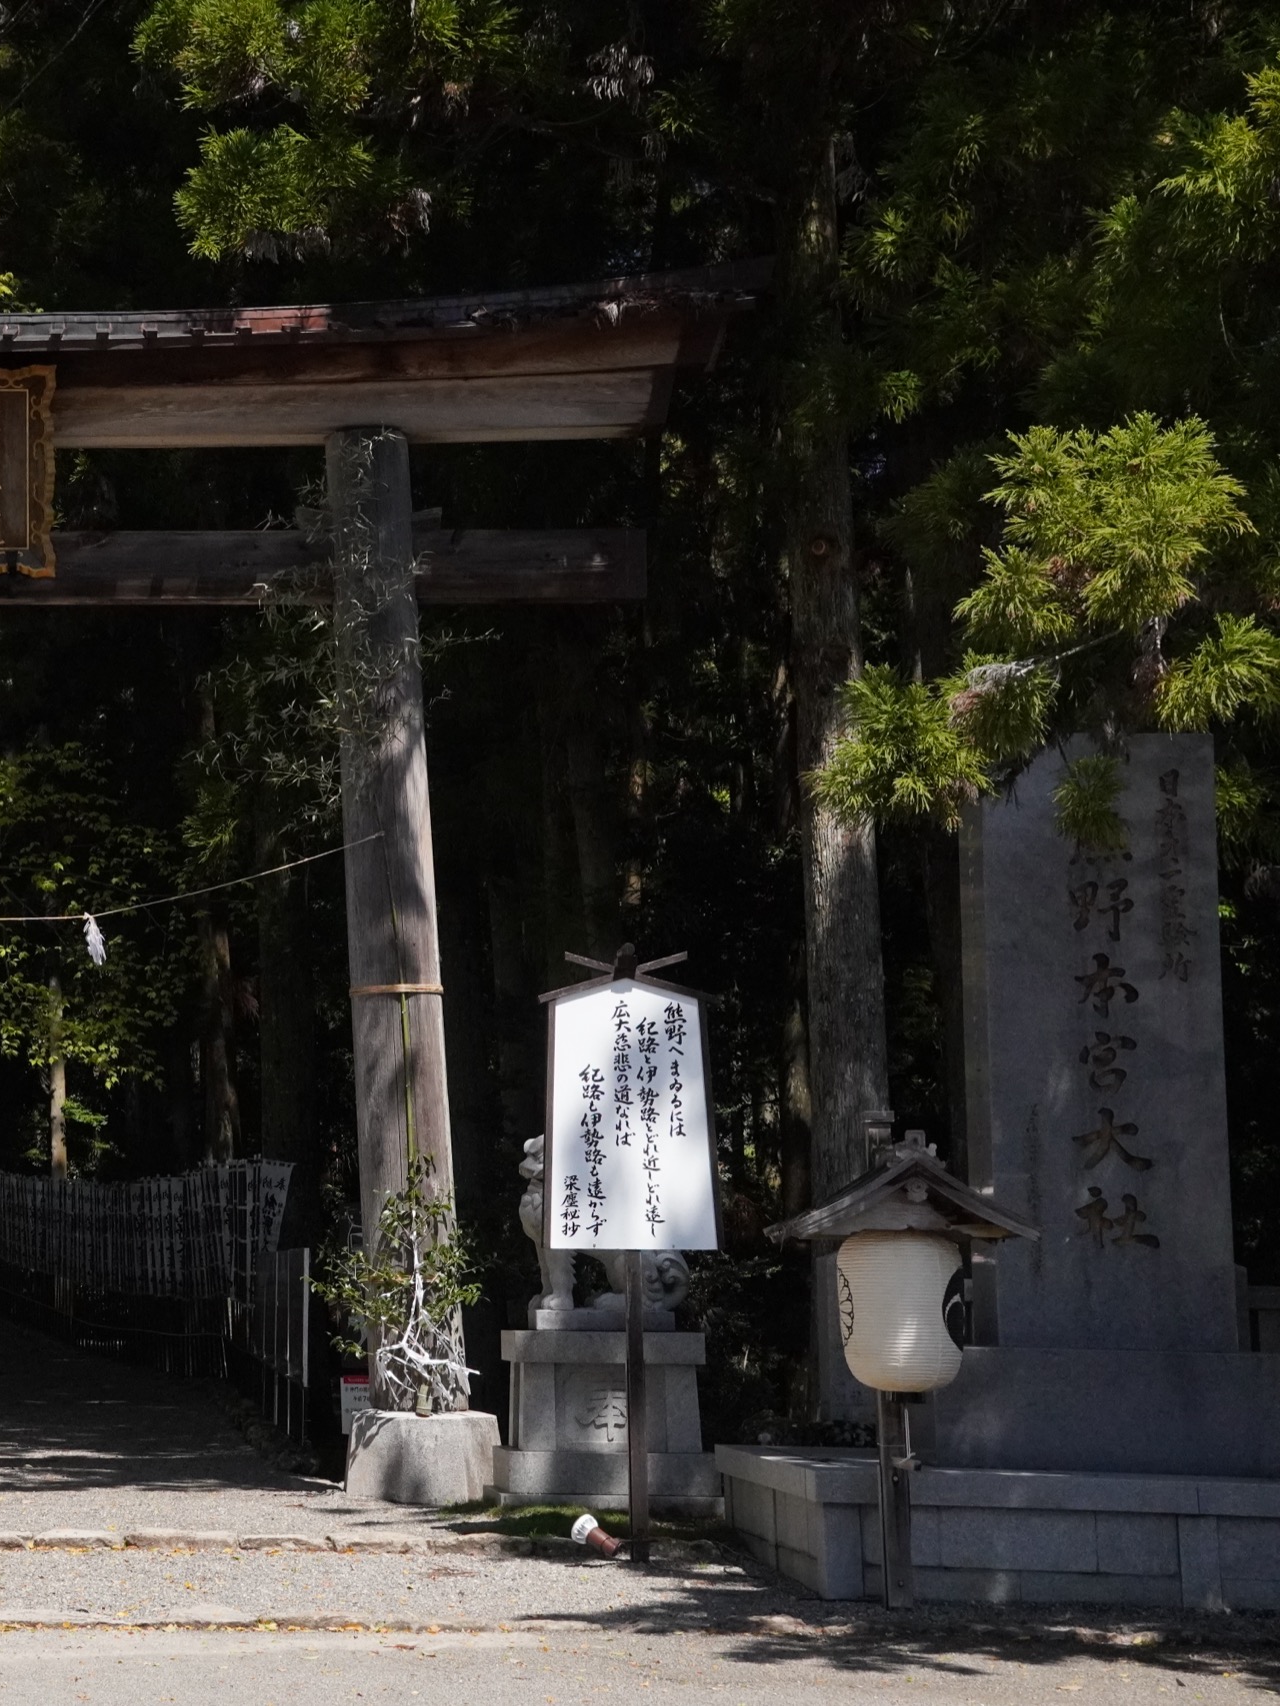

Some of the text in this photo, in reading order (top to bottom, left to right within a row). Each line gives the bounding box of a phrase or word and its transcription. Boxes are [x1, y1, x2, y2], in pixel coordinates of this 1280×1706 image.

[611, 1000, 637, 1147] 広大慈悲の道なれば
[1067, 846, 1161, 1250] 野本宮大社
